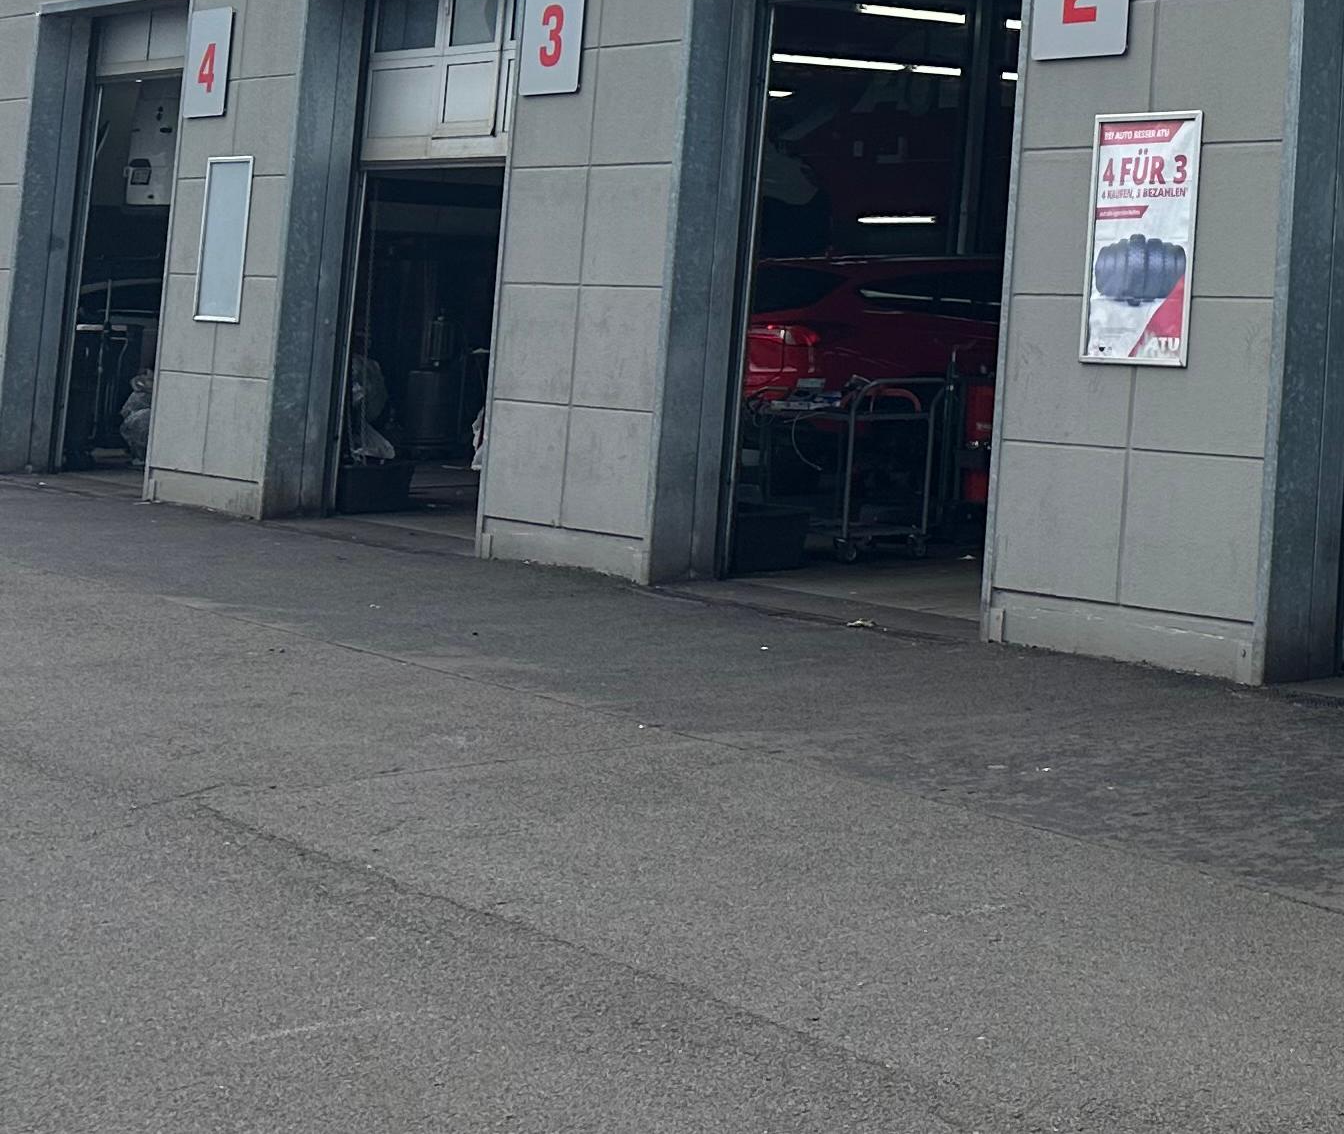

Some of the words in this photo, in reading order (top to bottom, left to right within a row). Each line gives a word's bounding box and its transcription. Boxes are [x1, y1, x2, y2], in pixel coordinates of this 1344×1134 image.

[539, 4, 563, 67] 3
[198, 43, 217, 92] 4
[1103, 158, 1115, 186] 4
[1120, 148, 1166, 186] FÜR
[1173, 155, 1188, 184] 3
